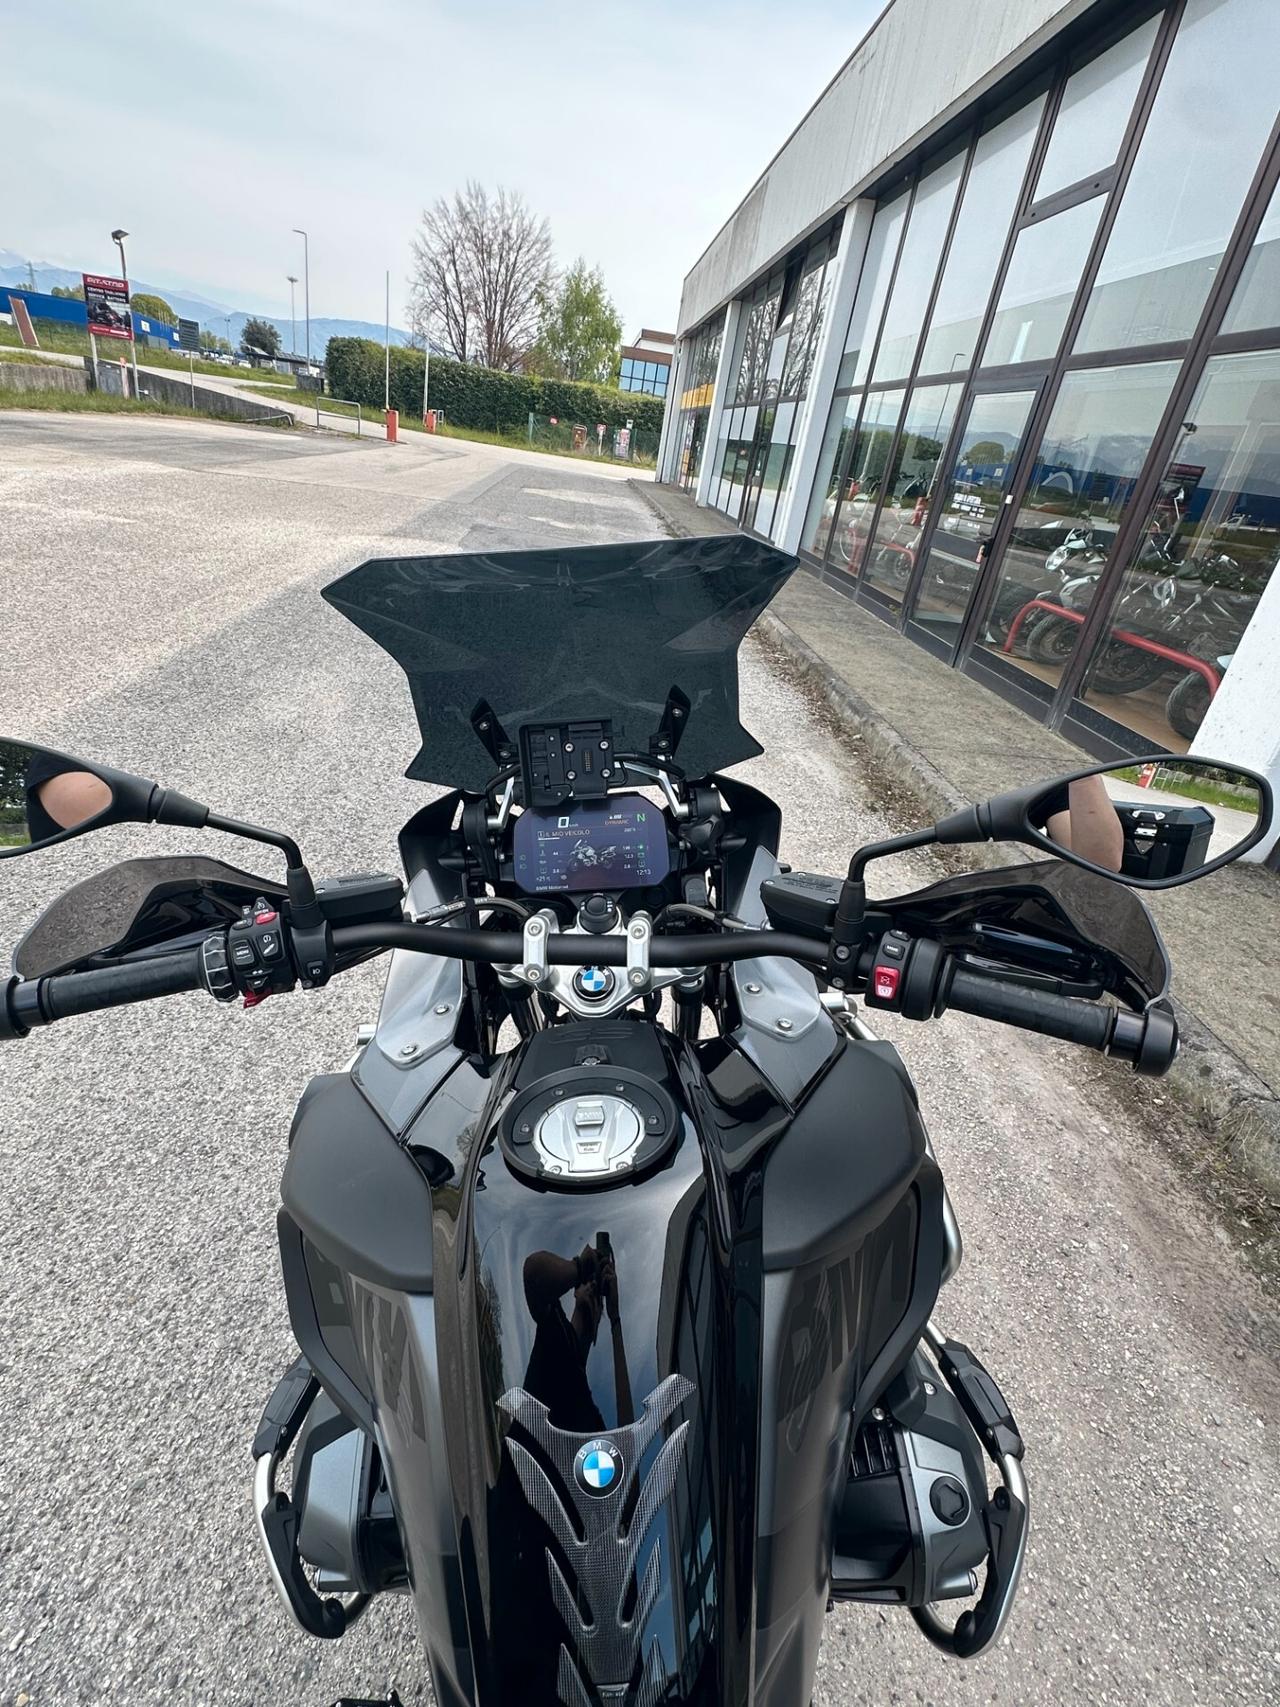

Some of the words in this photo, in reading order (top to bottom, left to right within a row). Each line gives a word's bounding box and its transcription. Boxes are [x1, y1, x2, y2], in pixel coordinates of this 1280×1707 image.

[558, 816, 570, 828] 0
[637, 813, 646, 822] N
[578, 1441, 619, 1460] BMW
